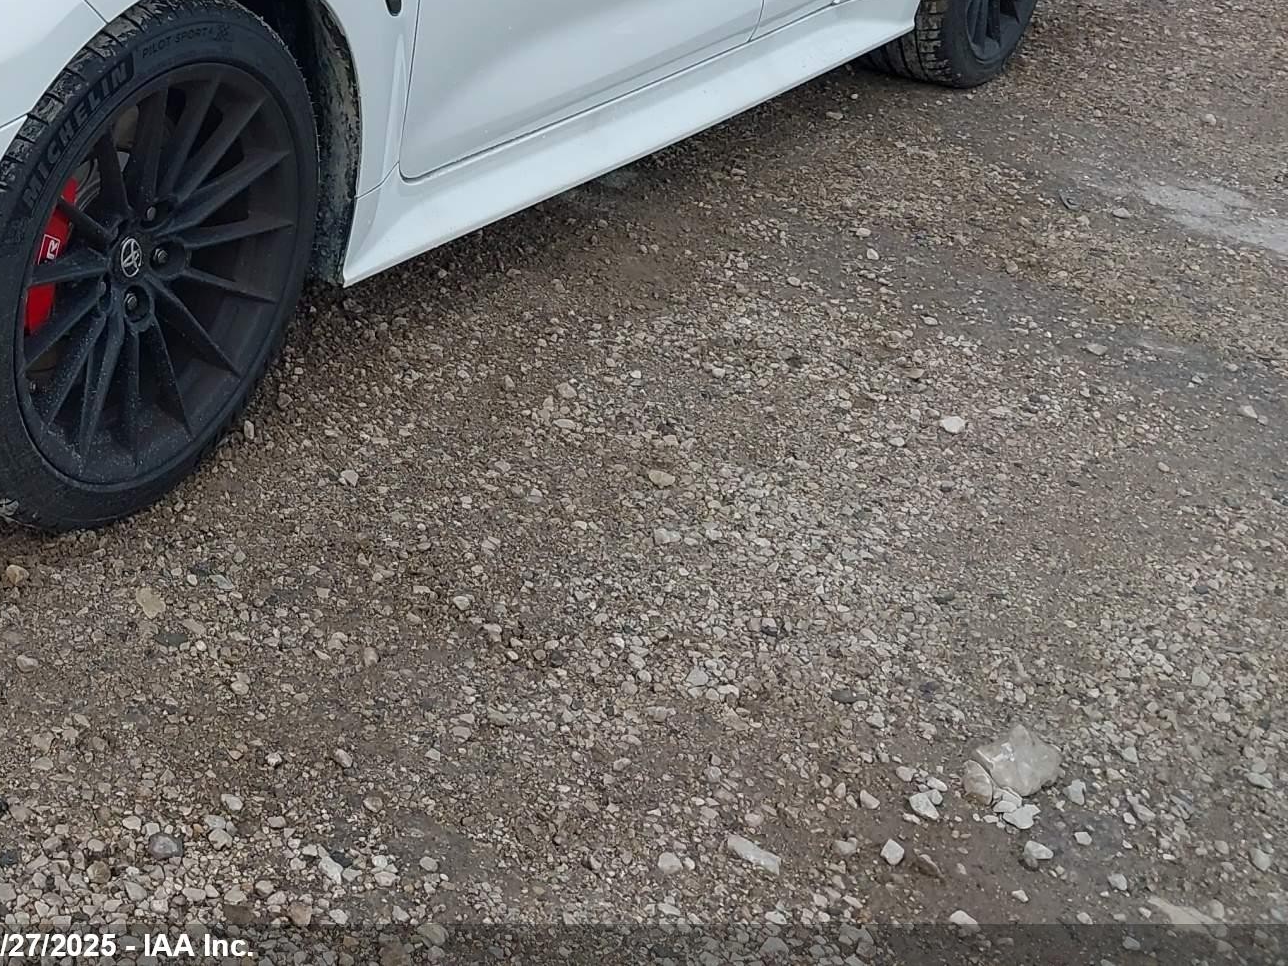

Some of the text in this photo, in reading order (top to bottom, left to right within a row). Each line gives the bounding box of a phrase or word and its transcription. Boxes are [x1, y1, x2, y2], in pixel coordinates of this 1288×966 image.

[142, 35, 172, 59] PILOT
[174, 26, 208, 44] SPORT
[23, 62, 129, 207] MICHELIN
